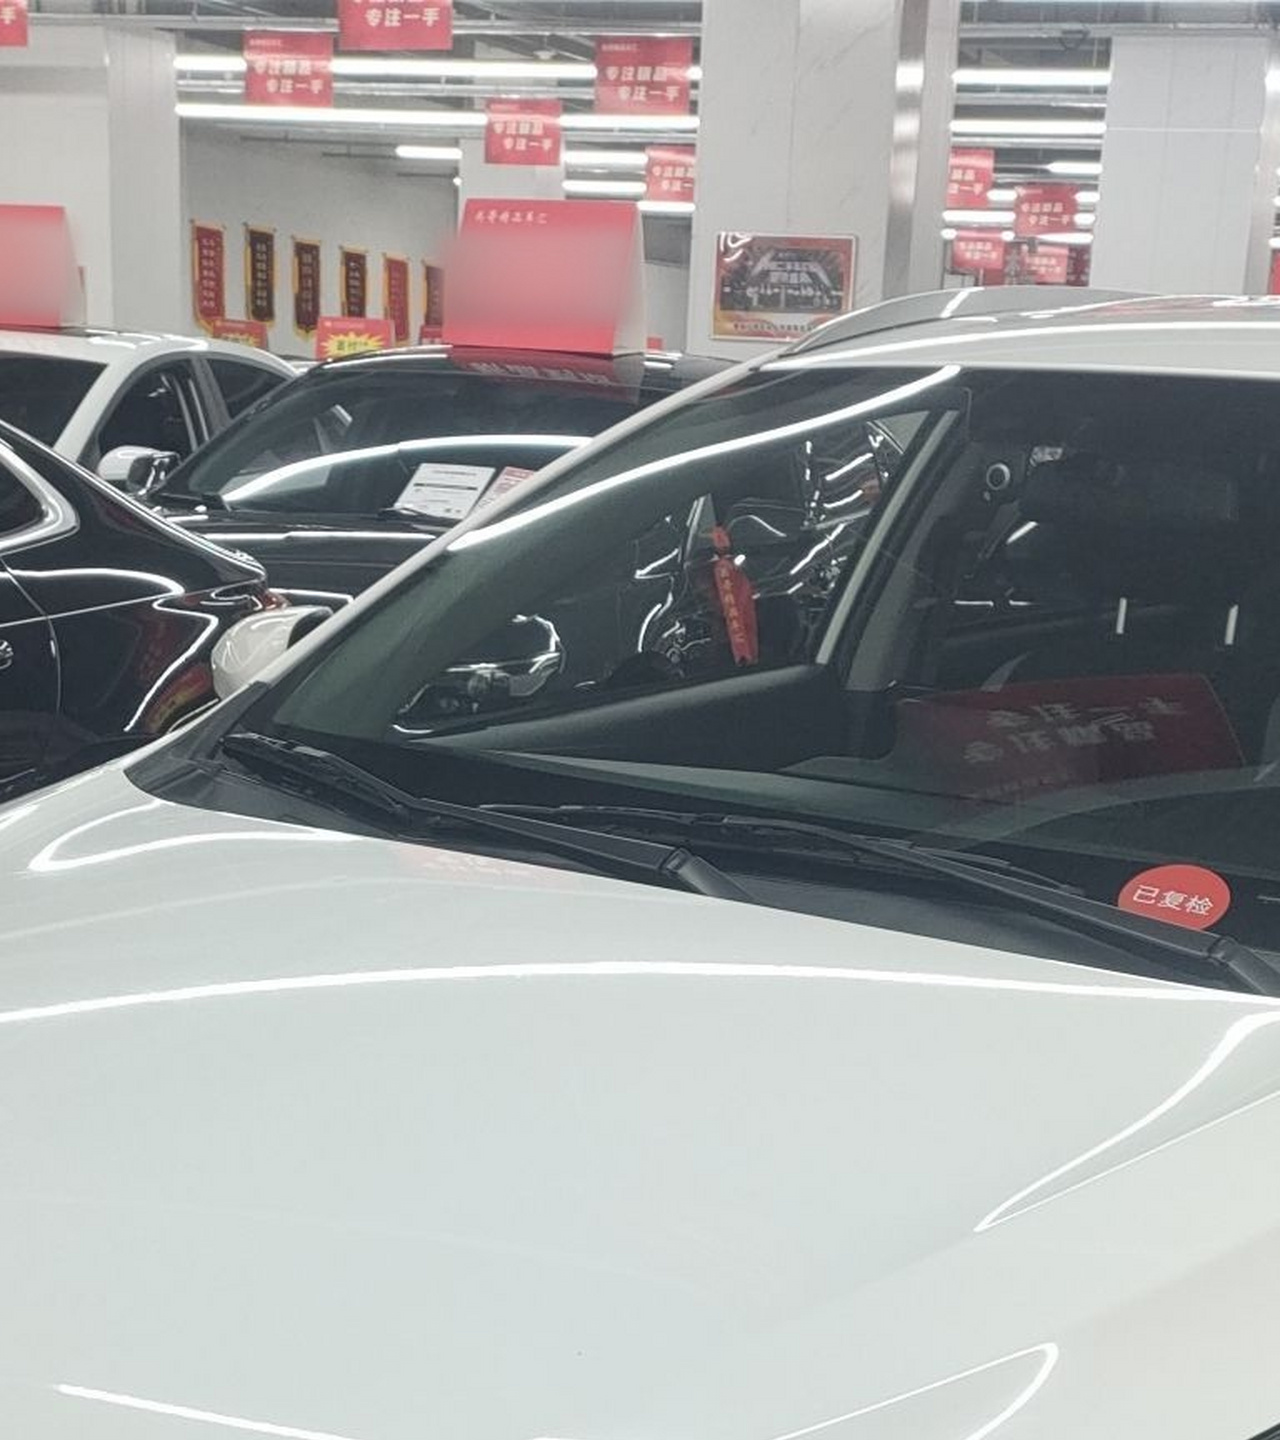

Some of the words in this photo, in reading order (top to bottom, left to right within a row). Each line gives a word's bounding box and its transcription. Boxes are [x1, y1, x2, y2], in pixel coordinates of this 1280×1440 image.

[364, 7, 441, 27] 专注一手
[266, 79, 324, 94] 专注一手
[618, 86, 680, 102] 专注一手
[503, 138, 552, 151] 专注一手
[1131, 883, 1214, 916] 已复检
